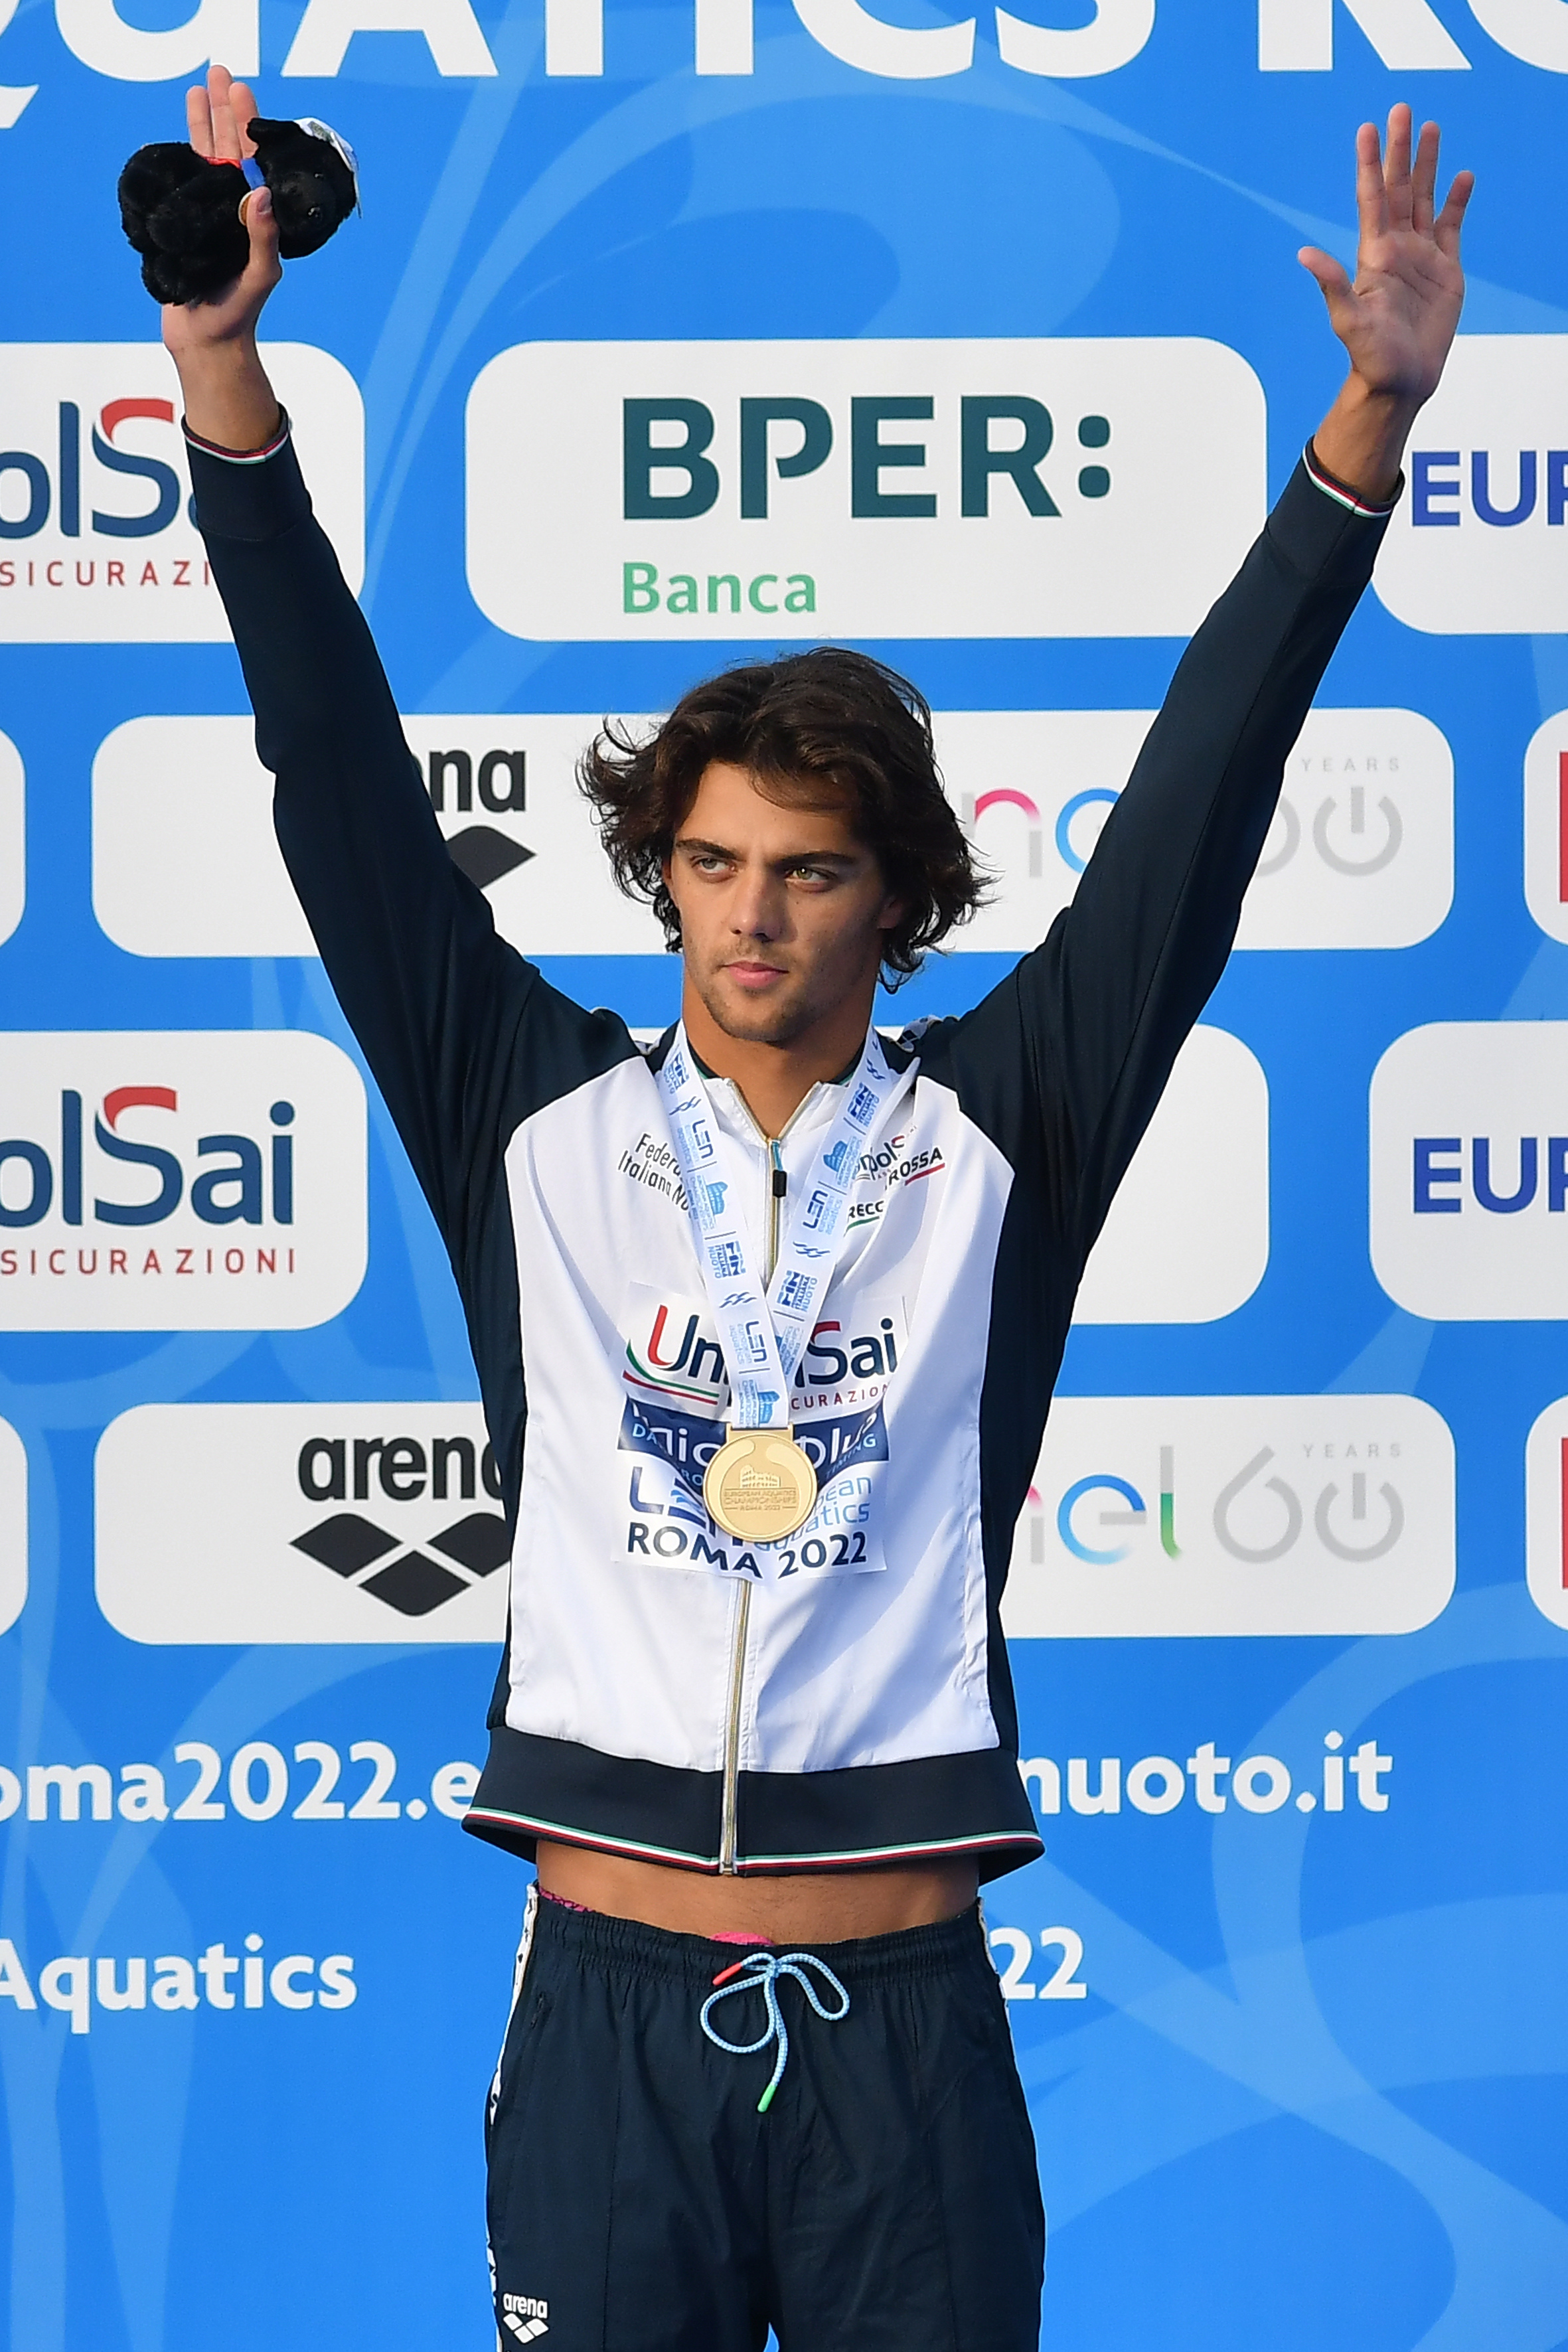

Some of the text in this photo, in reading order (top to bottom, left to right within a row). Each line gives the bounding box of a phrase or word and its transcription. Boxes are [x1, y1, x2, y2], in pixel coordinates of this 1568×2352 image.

[623, 562, 817, 614] Banca
[1301, 757, 1399, 771] YEARS
[0, 1249, 295, 1275] SICURAZIONI
[800, 1277, 818, 1312] NUOTO
[1302, 1443, 1401, 1458] YEARS
[627, 1522, 867, 1580] ROMA 2022
[503, 2292, 548, 2319] arena
